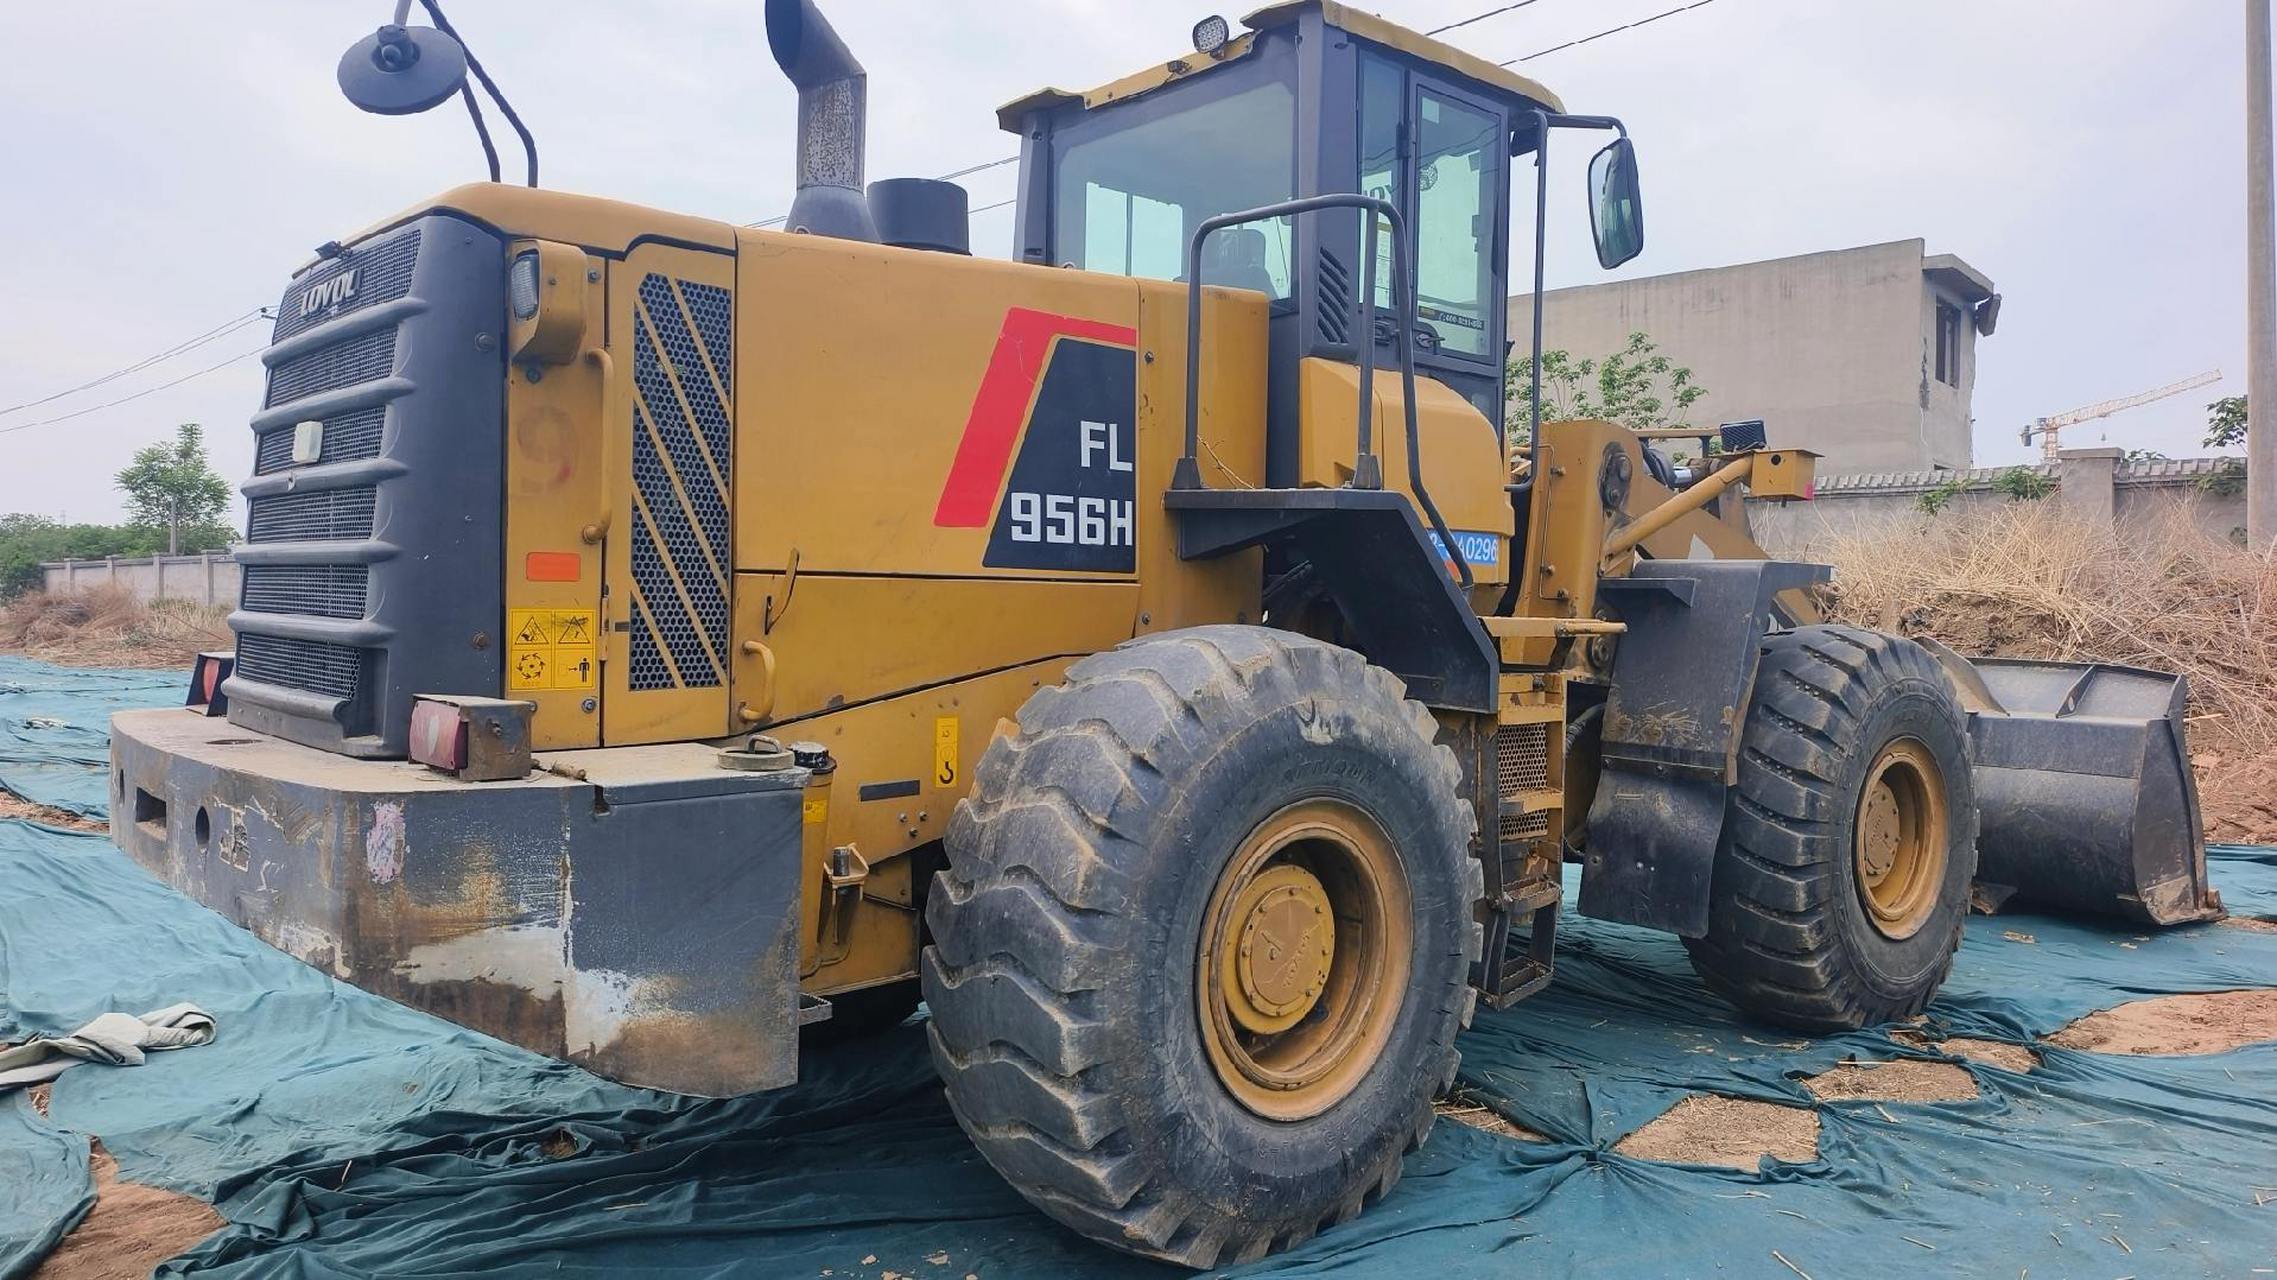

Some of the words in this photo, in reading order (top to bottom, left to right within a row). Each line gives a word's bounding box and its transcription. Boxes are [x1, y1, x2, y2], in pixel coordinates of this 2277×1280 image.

[300, 269, 357, 317] LOVOL
[1080, 420, 1133, 472] FL
[1011, 492, 1133, 546] 956H
